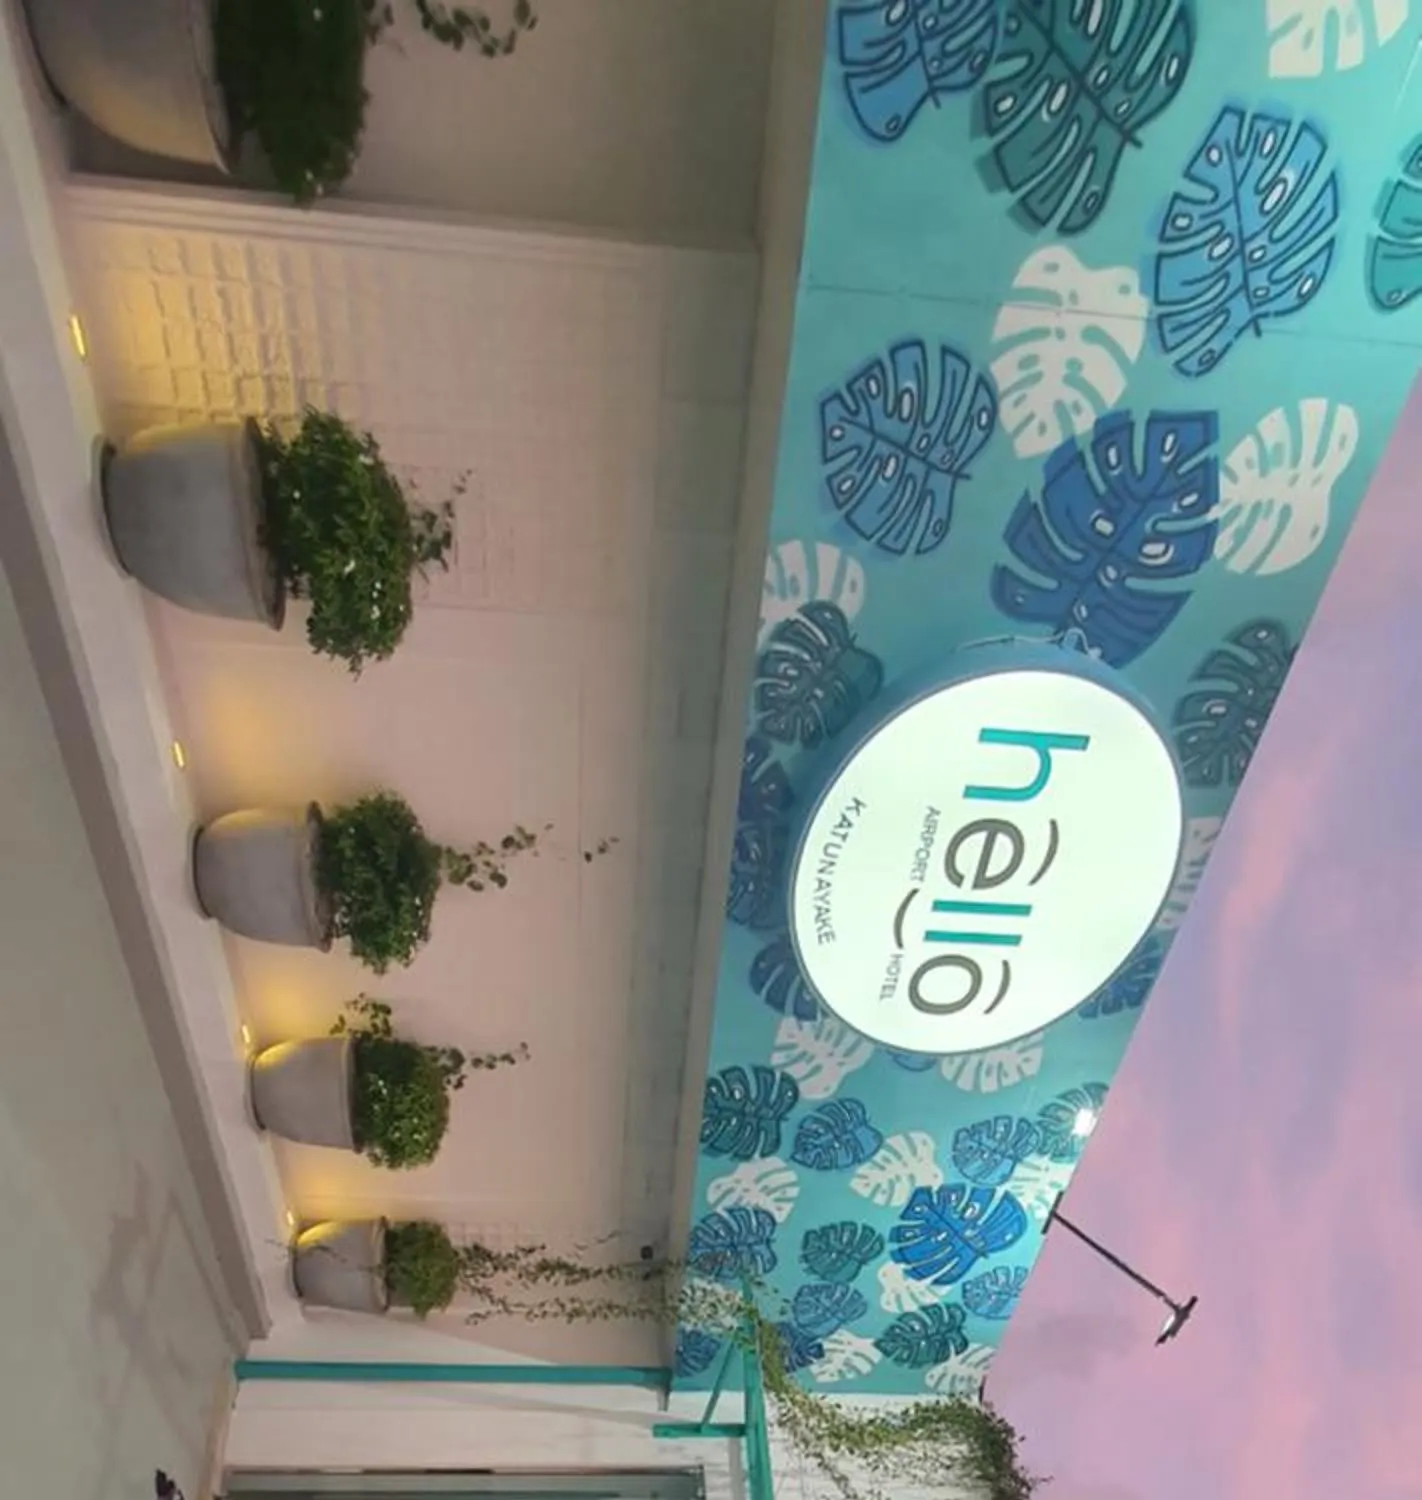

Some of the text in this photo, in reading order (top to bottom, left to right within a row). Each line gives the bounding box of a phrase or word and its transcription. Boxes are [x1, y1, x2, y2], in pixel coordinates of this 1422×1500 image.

[813, 797, 867, 945] KATUNAYAKE
[880, 806, 941, 1001] AIRPORT HOTEL
